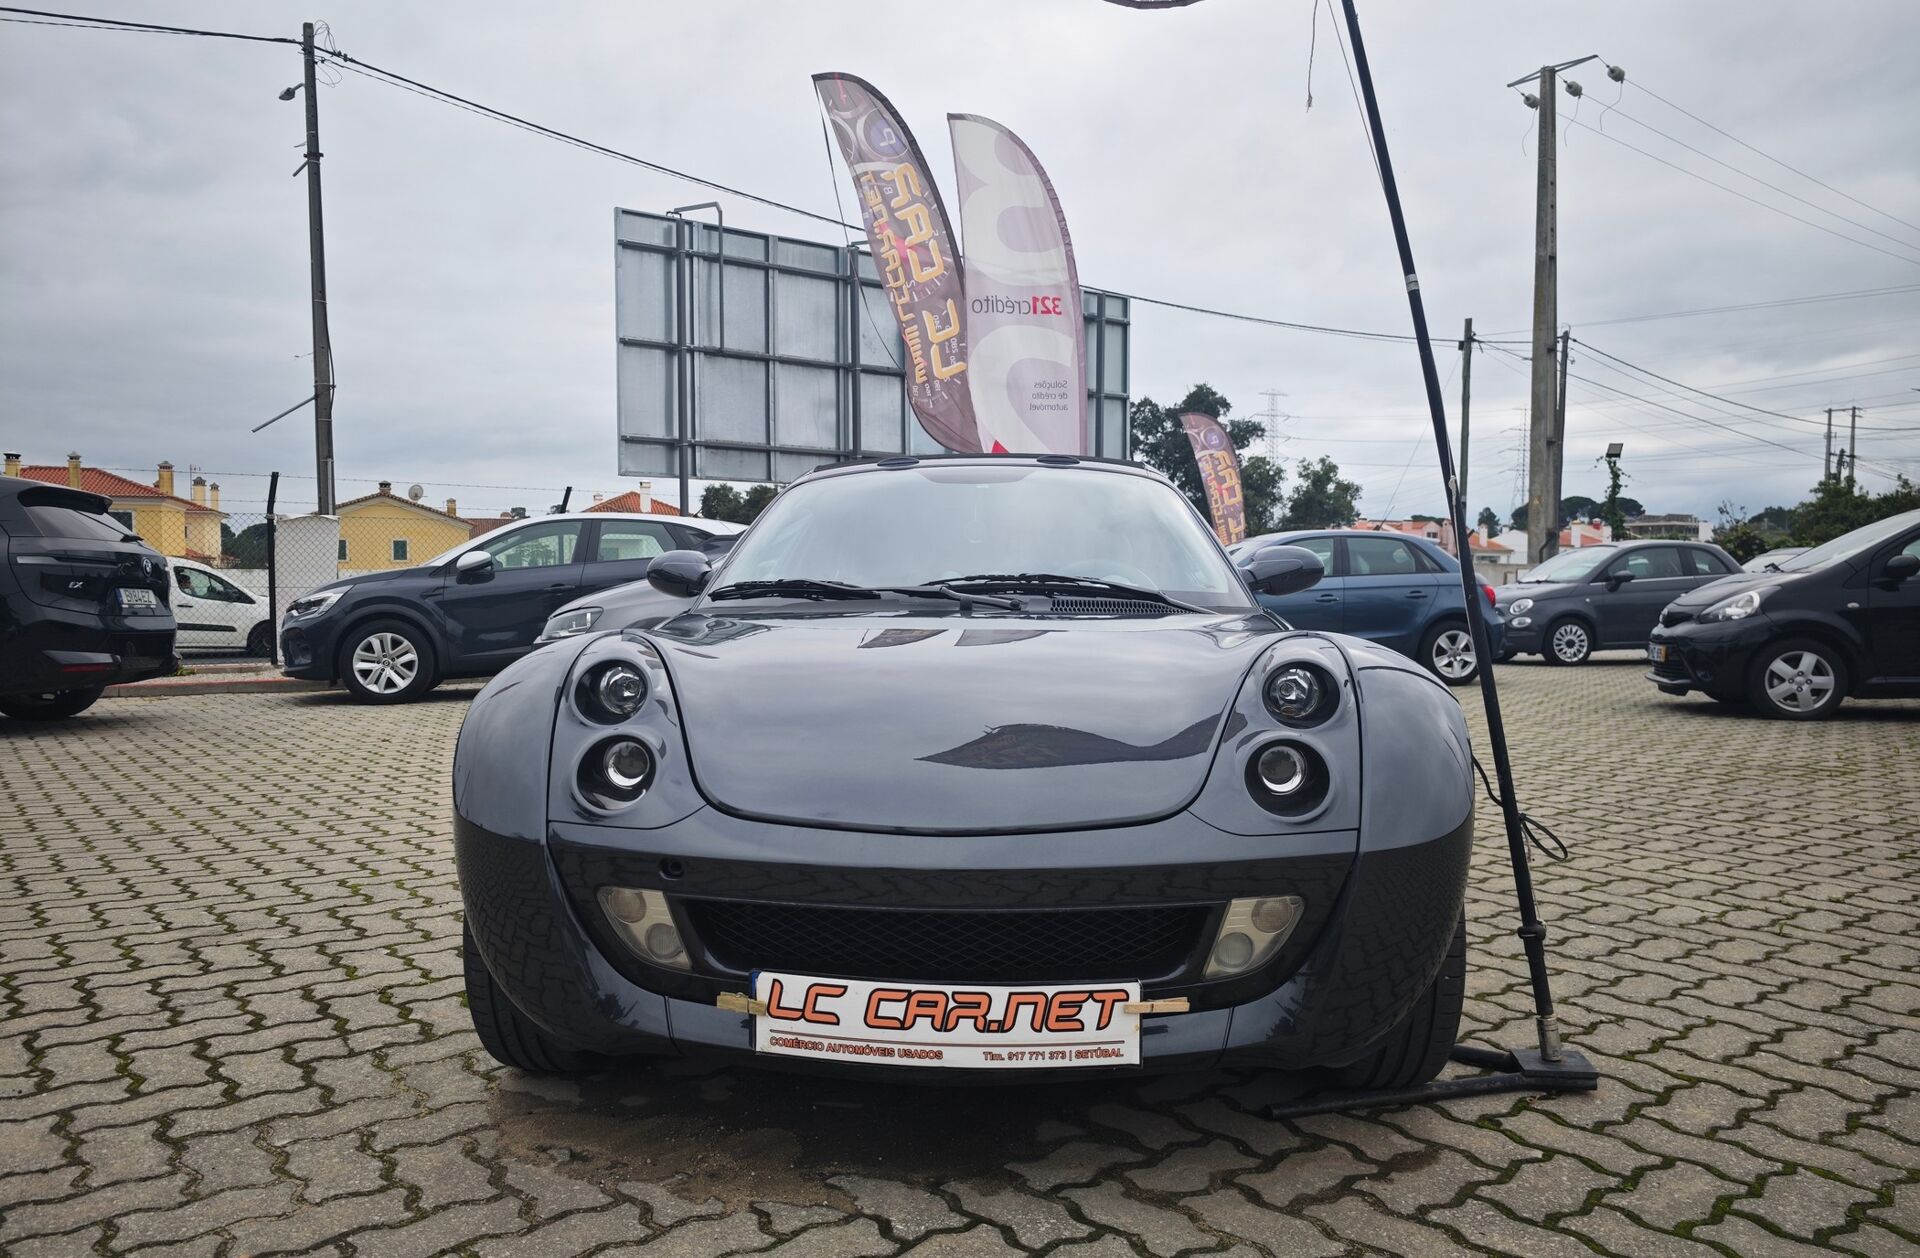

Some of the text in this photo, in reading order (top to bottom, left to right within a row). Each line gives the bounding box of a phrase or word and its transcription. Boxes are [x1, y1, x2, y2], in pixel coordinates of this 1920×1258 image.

[767, 978, 1130, 1033] LC CAR.NET
[770, 1036, 943, 1059] COMÉRCIO AUTOMÓVEIS USADOS
[1007, 1052, 1026, 1061] 917
[1028, 1052, 1046, 1061] 771
[1075, 1047, 1124, 1060] SETÚBAL
